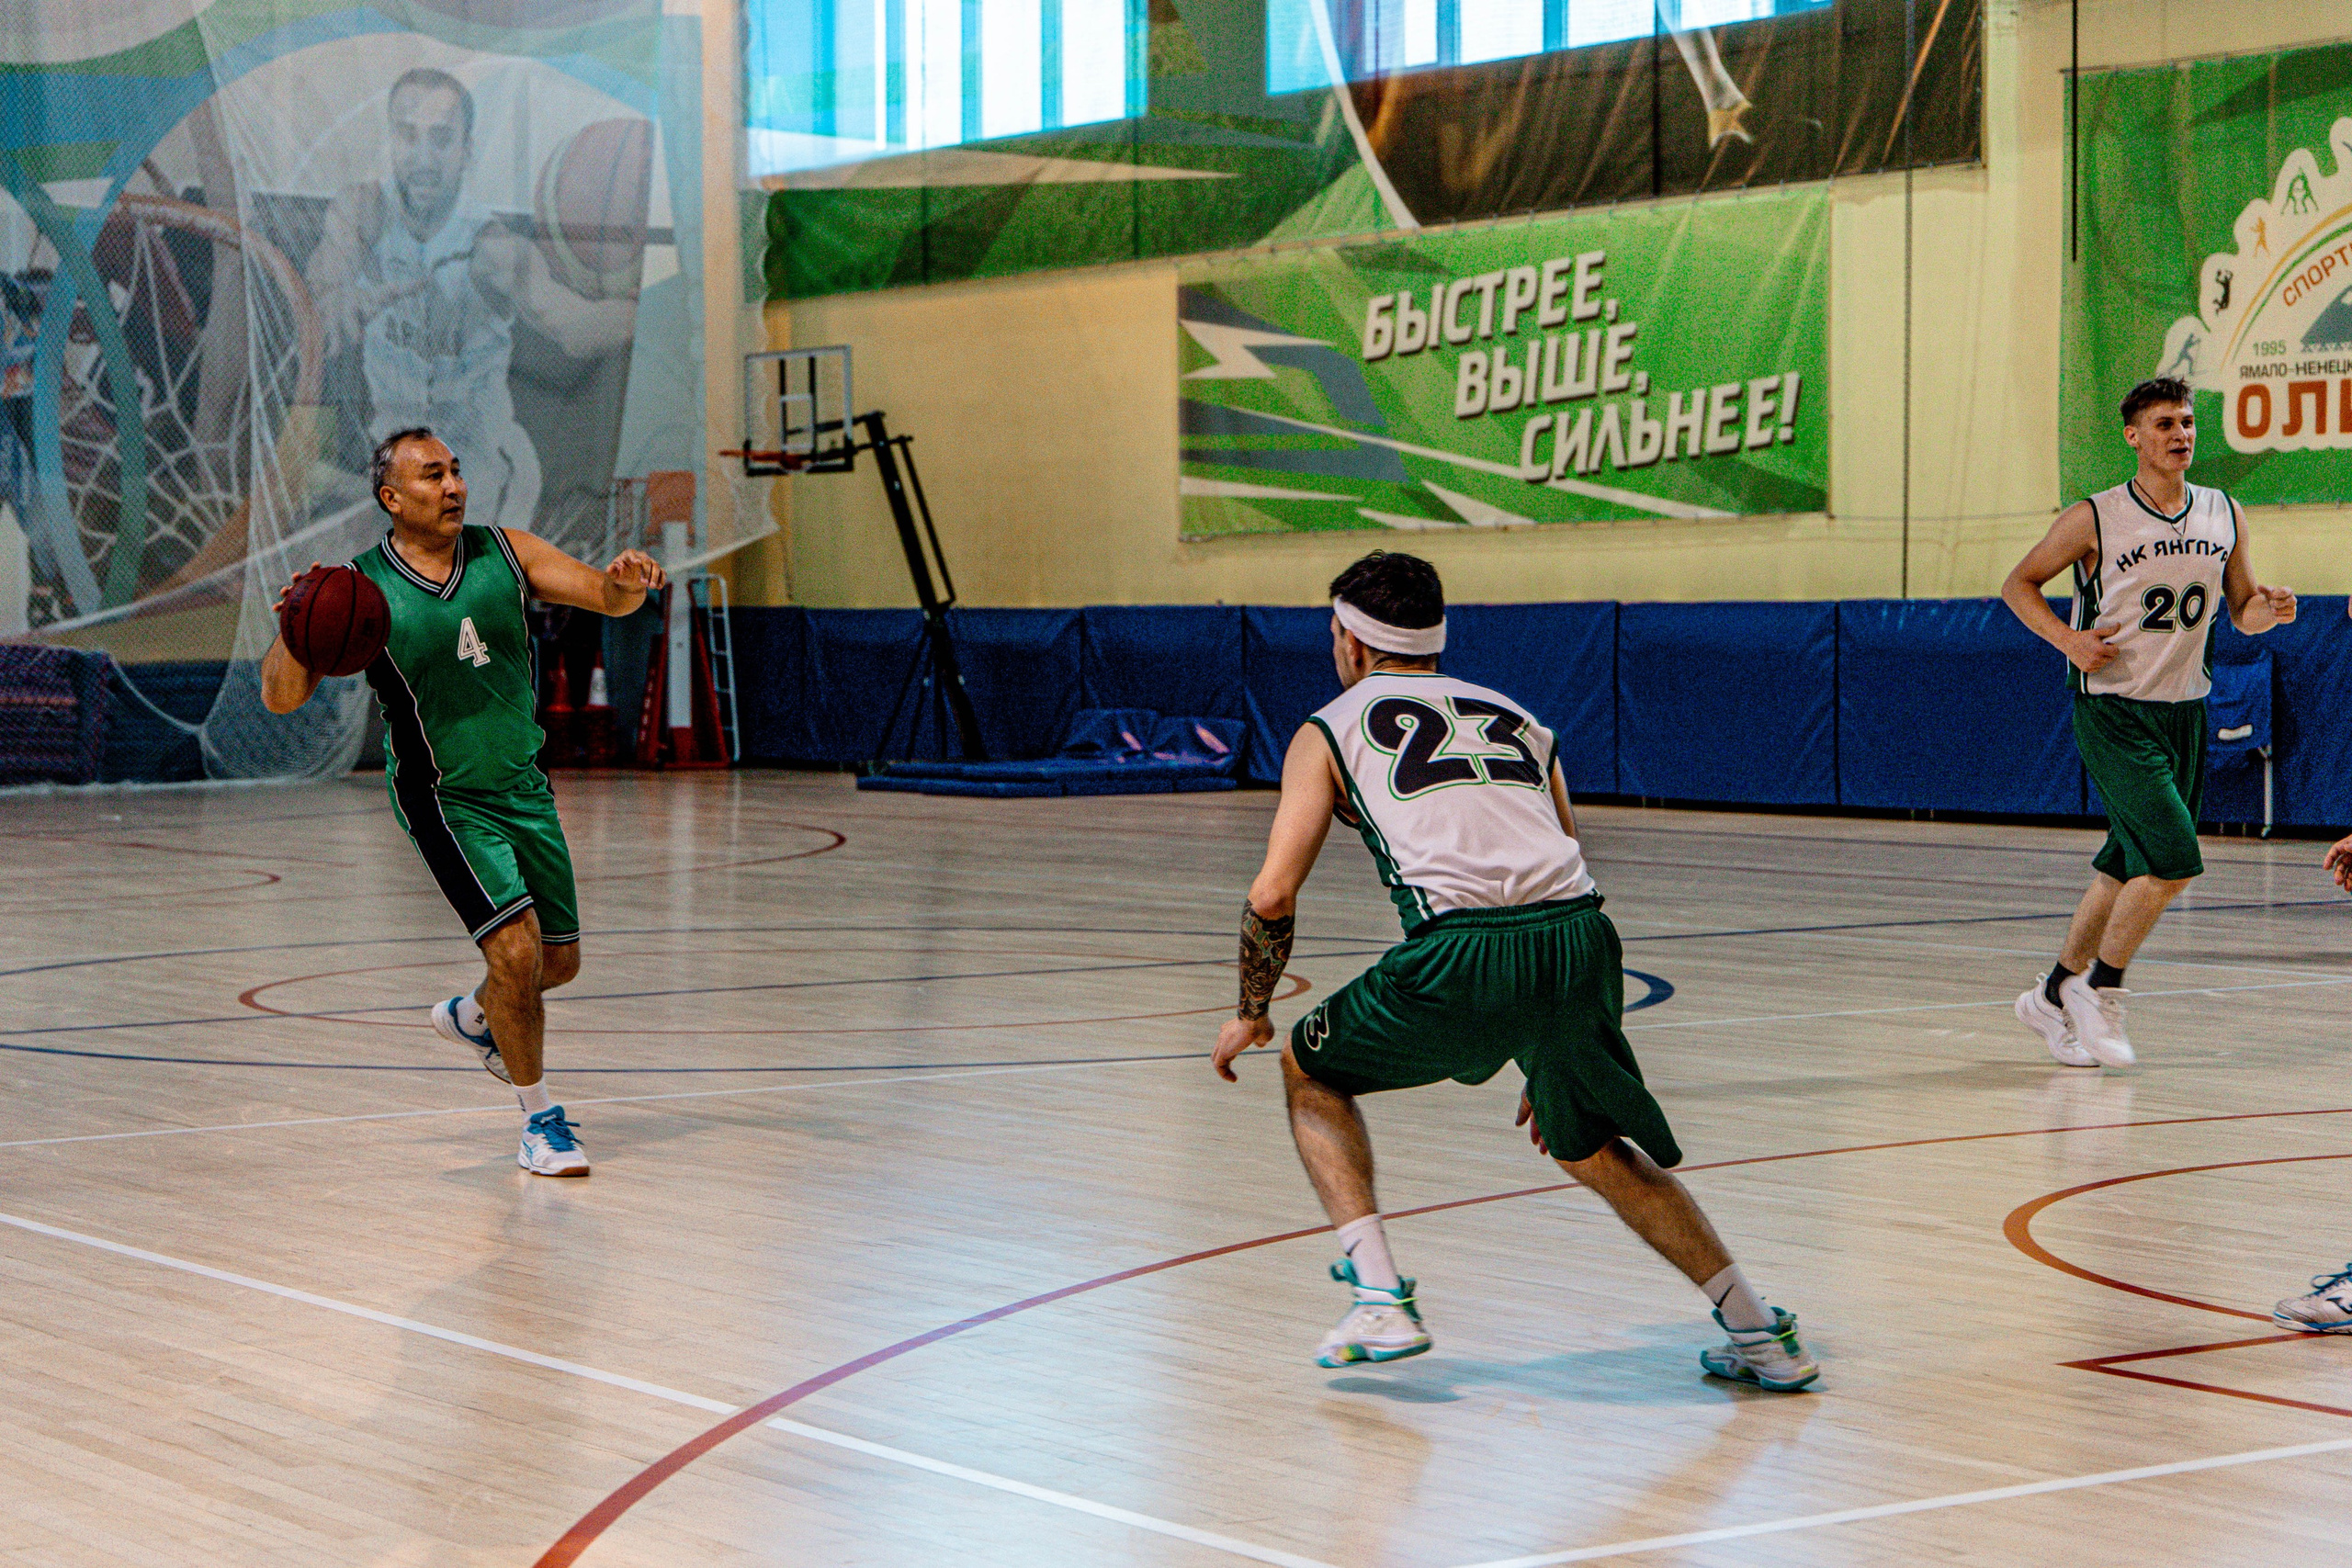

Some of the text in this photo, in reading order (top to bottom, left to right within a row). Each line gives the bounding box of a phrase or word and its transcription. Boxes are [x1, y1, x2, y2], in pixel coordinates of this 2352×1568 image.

[1363, 250, 1618, 361] БЫСТРЕЕ,
[1455, 321, 1648, 419] ВЫШЕ,
[2252, 340, 2287, 356] 1995
[1519, 371, 1800, 482] СИЛЬНЕЕ!
[2116, 544, 2148, 573] НК
[458, 616, 491, 668] 4
[2138, 581, 2209, 634] 20
[1361, 694, 1548, 802] 23
